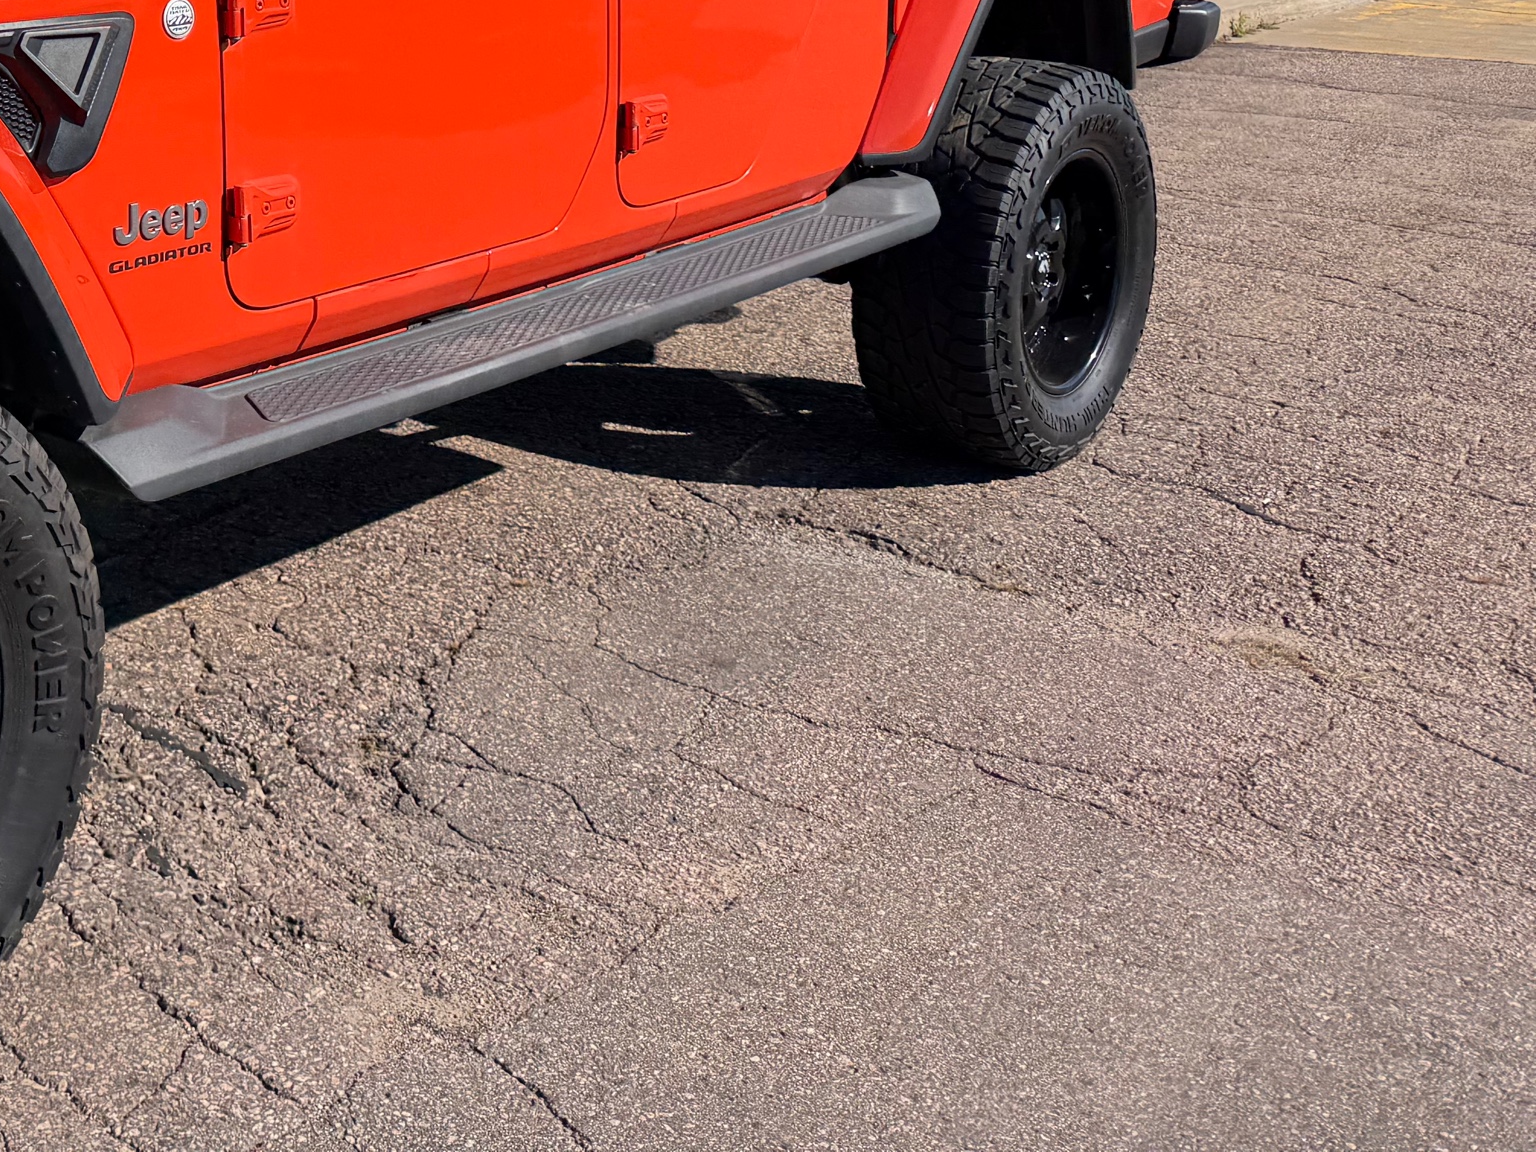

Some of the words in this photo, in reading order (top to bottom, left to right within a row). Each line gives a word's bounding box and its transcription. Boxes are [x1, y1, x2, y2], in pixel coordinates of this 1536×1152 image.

[113, 199, 208, 246] Jeep
[108, 242, 213, 274] GLADIATOR
[13, 557, 70, 735] POWER
